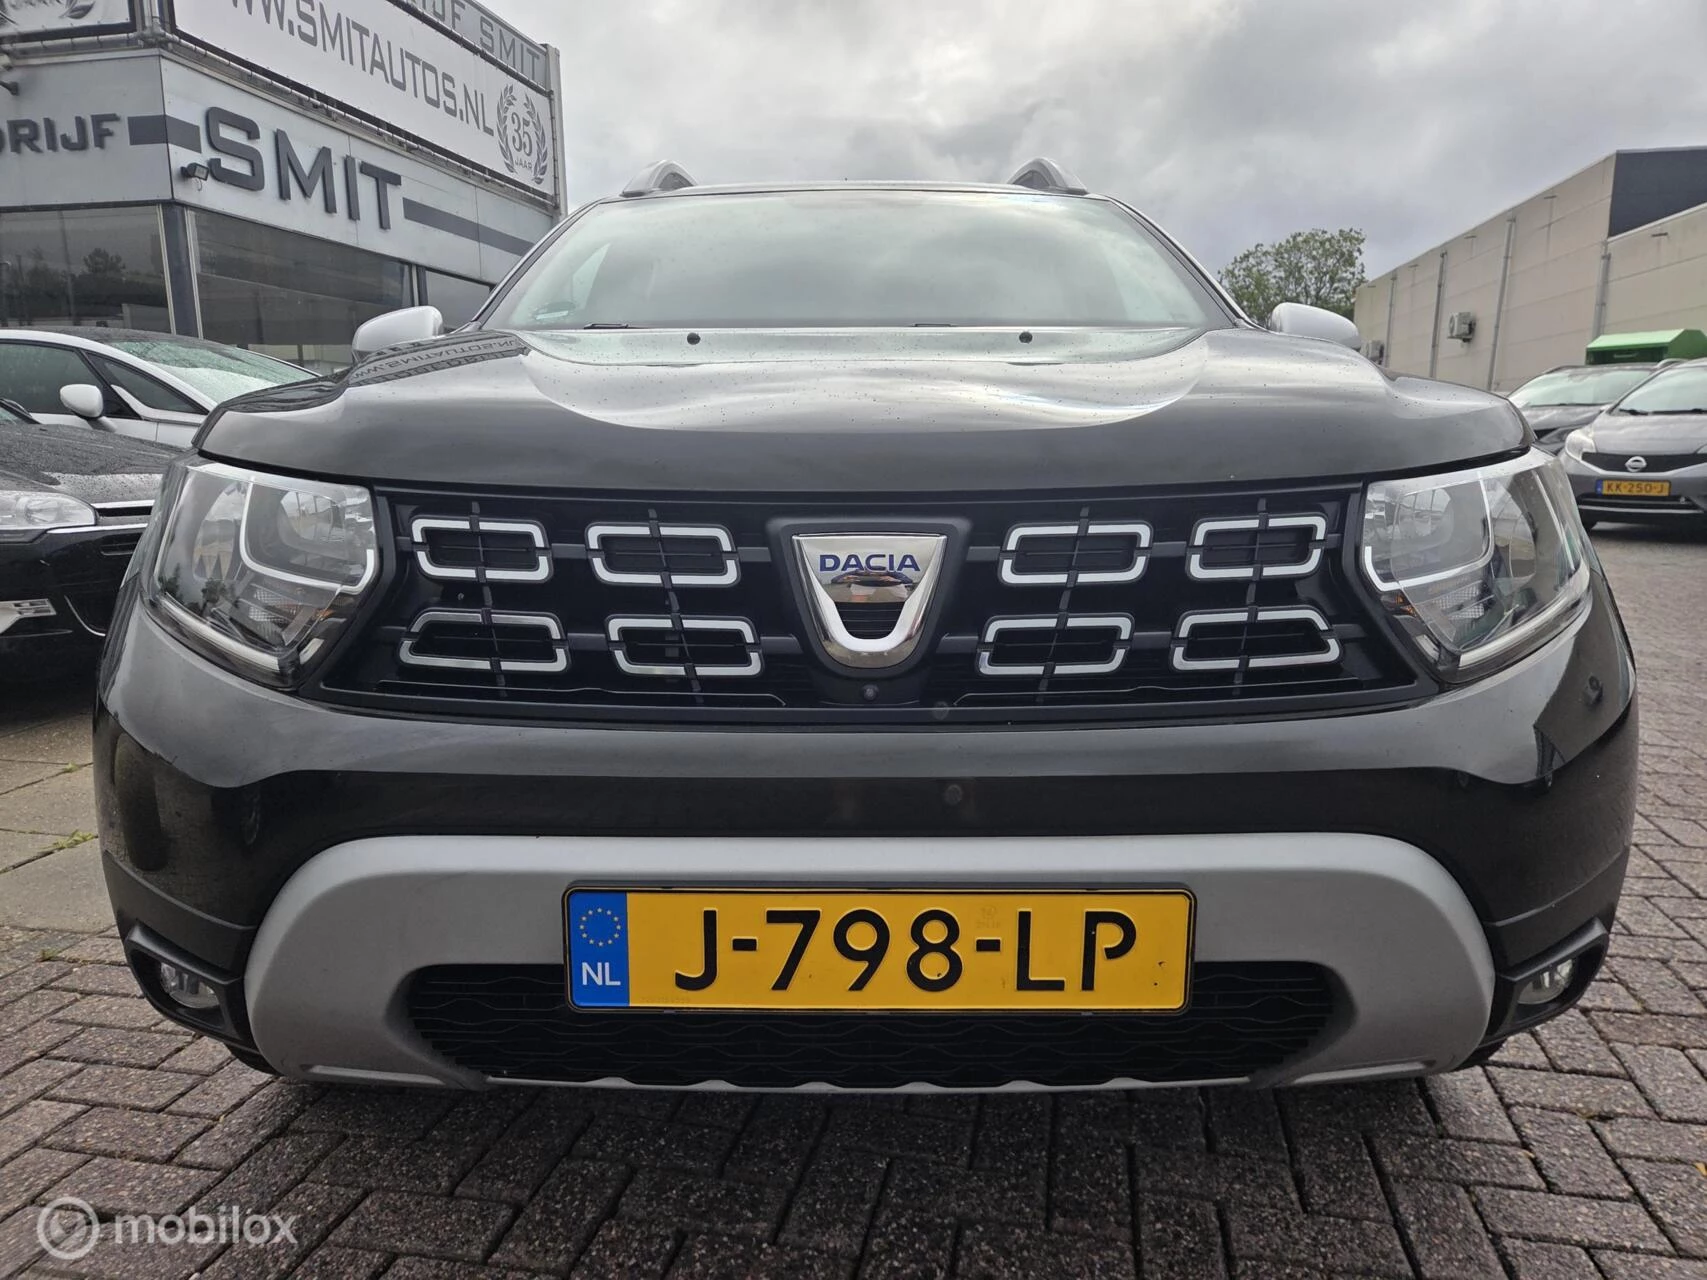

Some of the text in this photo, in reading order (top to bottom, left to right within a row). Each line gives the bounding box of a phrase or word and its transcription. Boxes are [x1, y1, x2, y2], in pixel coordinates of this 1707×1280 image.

[479, 15, 540, 82] SMIT
[0, 112, 121, 154] RIJF
[511, 112, 533, 157] 35
[206, 106, 402, 231] SMIT
[514, 157, 533, 171] JAAR
[819, 554, 921, 572] DACIA
[674, 908, 1137, 992] J-798-LP
[581, 961, 621, 986] NL
